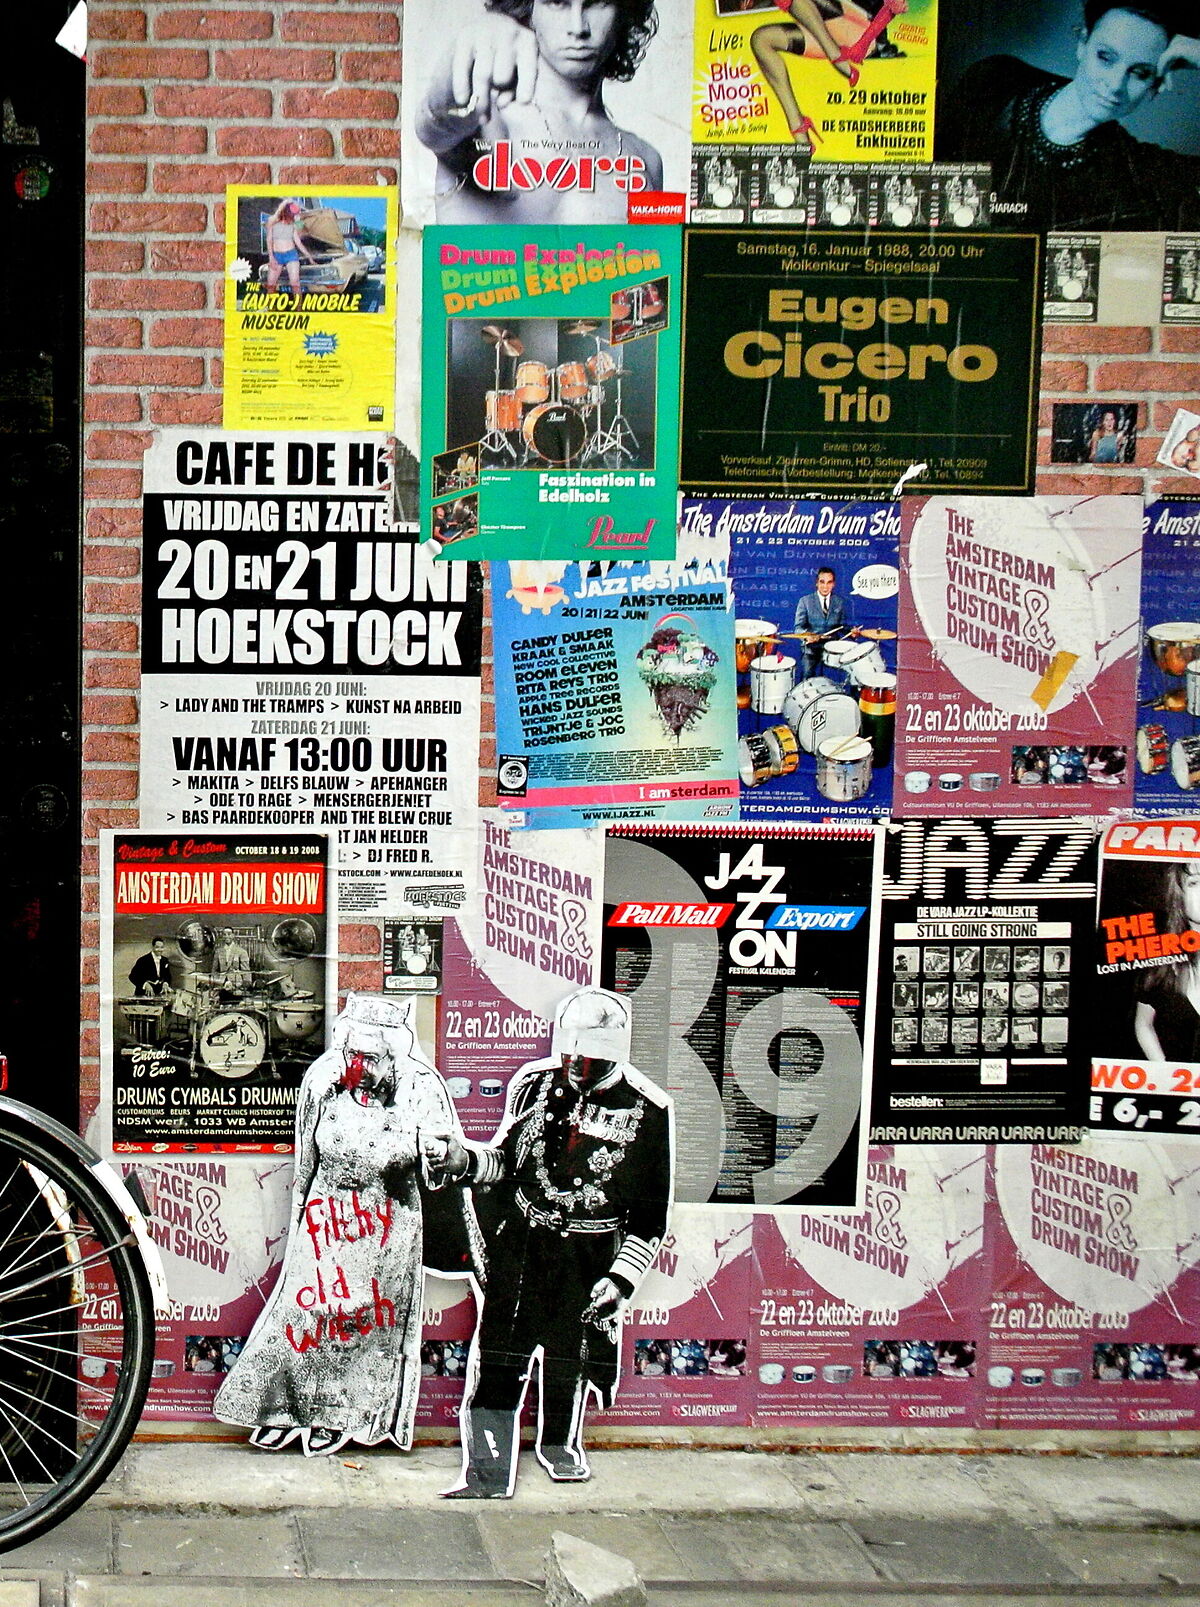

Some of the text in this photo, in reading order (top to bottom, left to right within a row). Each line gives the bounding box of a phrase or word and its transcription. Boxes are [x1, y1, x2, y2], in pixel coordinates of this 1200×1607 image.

[709, 29, 743, 52] Live:
[711, 63, 751, 82] Blue
[708, 83, 761, 103] Moon
[827, 91, 927, 104] zo. 29 oktober
[701, 99, 769, 126] Special
[823, 121, 925, 133] DE STADSHERBERG
[522, 140, 600, 150] The Very Best Of
[856, 134, 925, 148] Enkhuizen
[473, 139, 646, 193] doors
[737, 242, 984, 258] Samstag, 16. Januar 1988, 20.00 Uhr
[246, 282, 261, 291] THE
[444, 250, 661, 314] Drum Explosion
[302, 294, 361, 310] MOBILE
[768, 290, 949, 331] Eugen
[241, 315, 310, 329] MUSEUM
[723, 331, 998, 382] Cicero
[818, 386, 891, 423] Trio
[176, 441, 336, 486] CAFE DE
[539, 473, 655, 487] Faszination in
[539, 489, 610, 503] Edelholz
[164, 501, 317, 532] VRIJDAG EN
[717, 506, 865, 536] Amsterdam Drum
[945, 508, 974, 537] THE
[158, 539, 467, 602] 20 EN 21 JUNI
[946, 533, 1055, 590] AMSTERDAM
[946, 558, 1021, 607] VINTAGE
[946, 584, 1020, 636] CUSTOM
[161, 608, 462, 665] HOEKSTOCK
[511, 635, 559, 651] CANDY
[947, 612, 997, 658] DRUM
[175, 699, 324, 713] LADY AND THE TRAMPS
[519, 701, 562, 717] HANS
[906, 704, 1012, 731] 22 en 23 oktober
[172, 738, 447, 772] VANAF 13:00 UUR
[188, 776, 239, 790] MAKITA
[261, 777, 349, 790] DELFS BLAUW
[371, 777, 447, 791] APEHANGER
[183, 810, 452, 825] BAS PAARDEKOOPER AND THE BLEW CRUE
[619, 905, 723, 925] Pall Mall
[779, 907, 855, 929] Export
[917, 924, 1037, 937] STILL GOING STRONG
[729, 930, 796, 967] ON
[118, 1088, 236, 1105] DRUMS CYMBALS
[890, 1097, 944, 1108] bestellen:
[155, 1118, 188, 1126] werf,
[194, 1118, 222, 1126] 1033
[227, 1118, 246, 1126] WB
